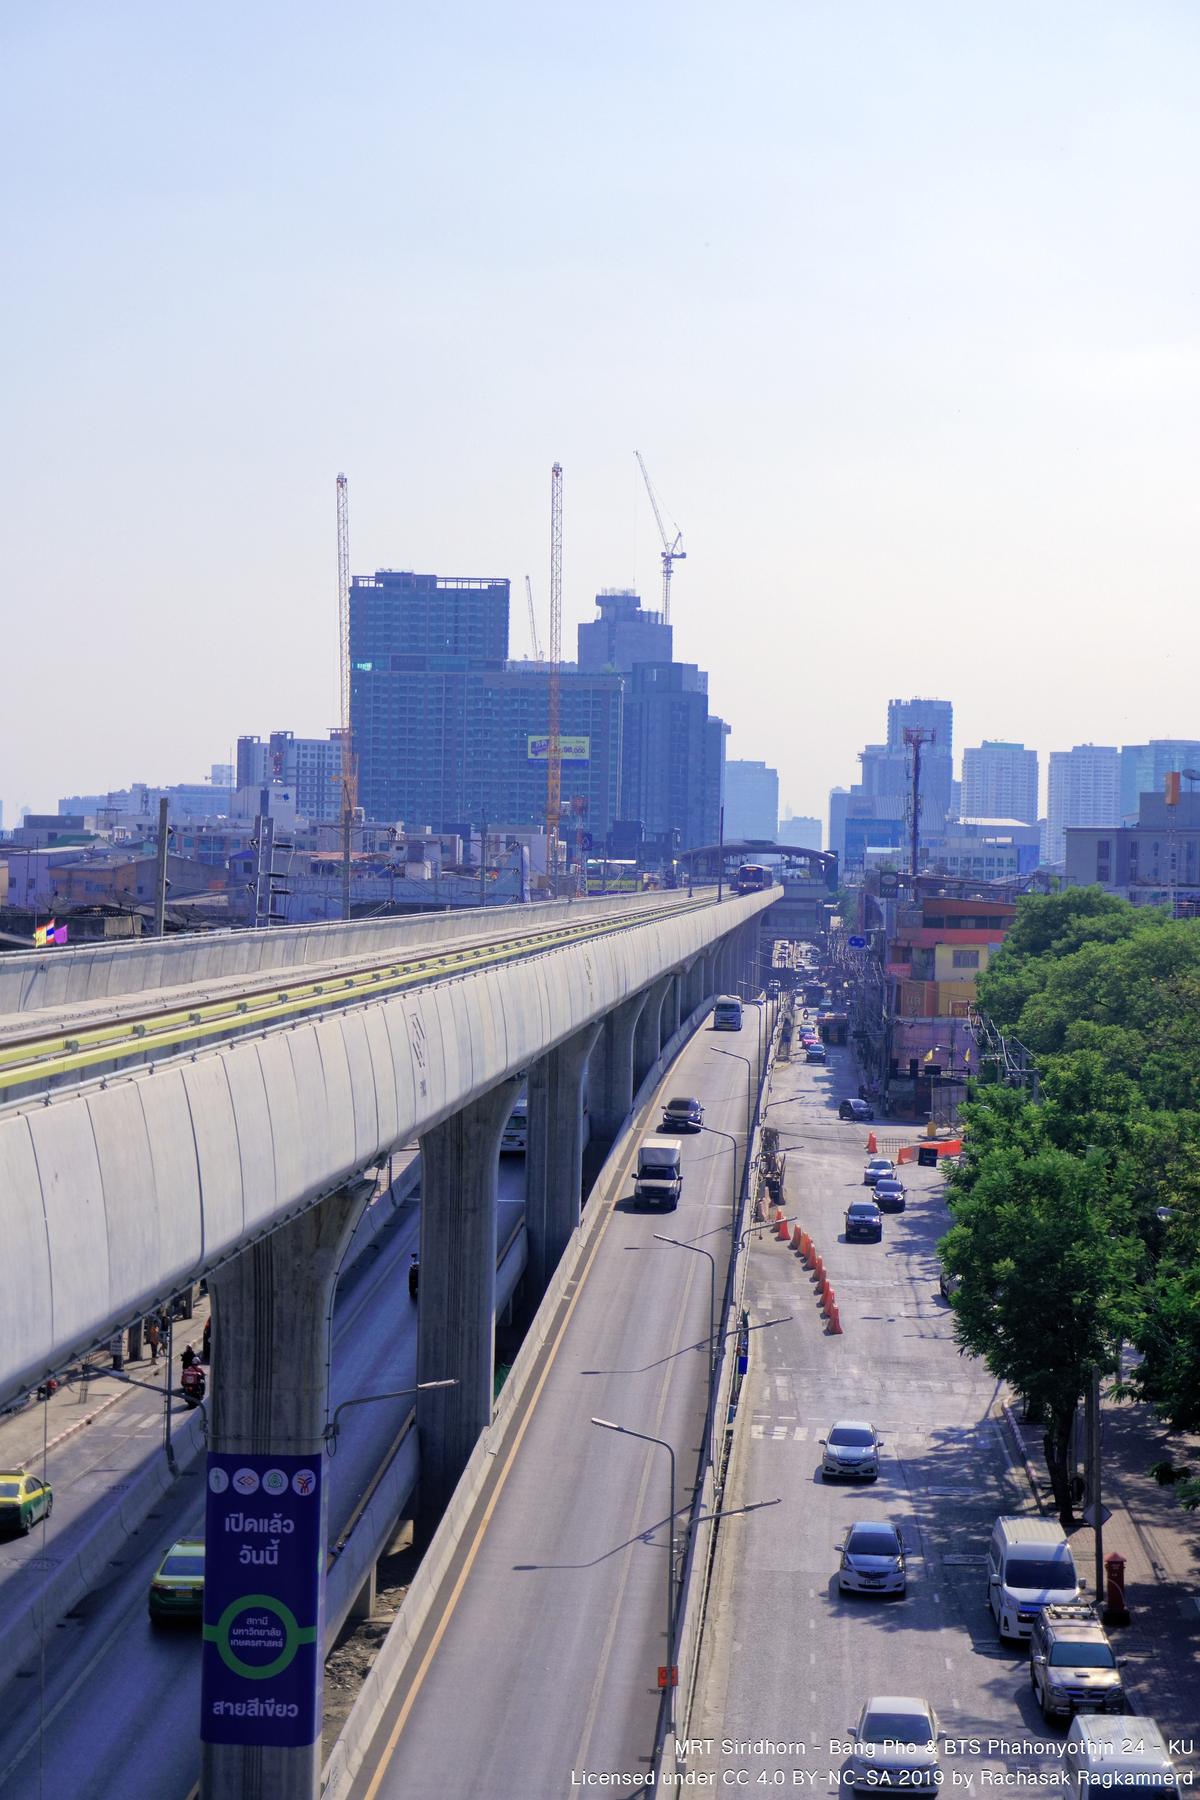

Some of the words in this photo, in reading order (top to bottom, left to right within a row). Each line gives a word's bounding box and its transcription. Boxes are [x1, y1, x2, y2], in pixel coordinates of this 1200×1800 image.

[225, 1512, 295, 1534] เปิดแล้ว
[239, 1538, 280, 1565] วันนี้
[246, 1616, 269, 1625] สถานี
[232, 1627, 282, 1637] มหาวิทยาลัย
[230, 1638, 284, 1648] เกษตรศาสตร์
[212, 1697, 299, 1718] สายสีเขียว
